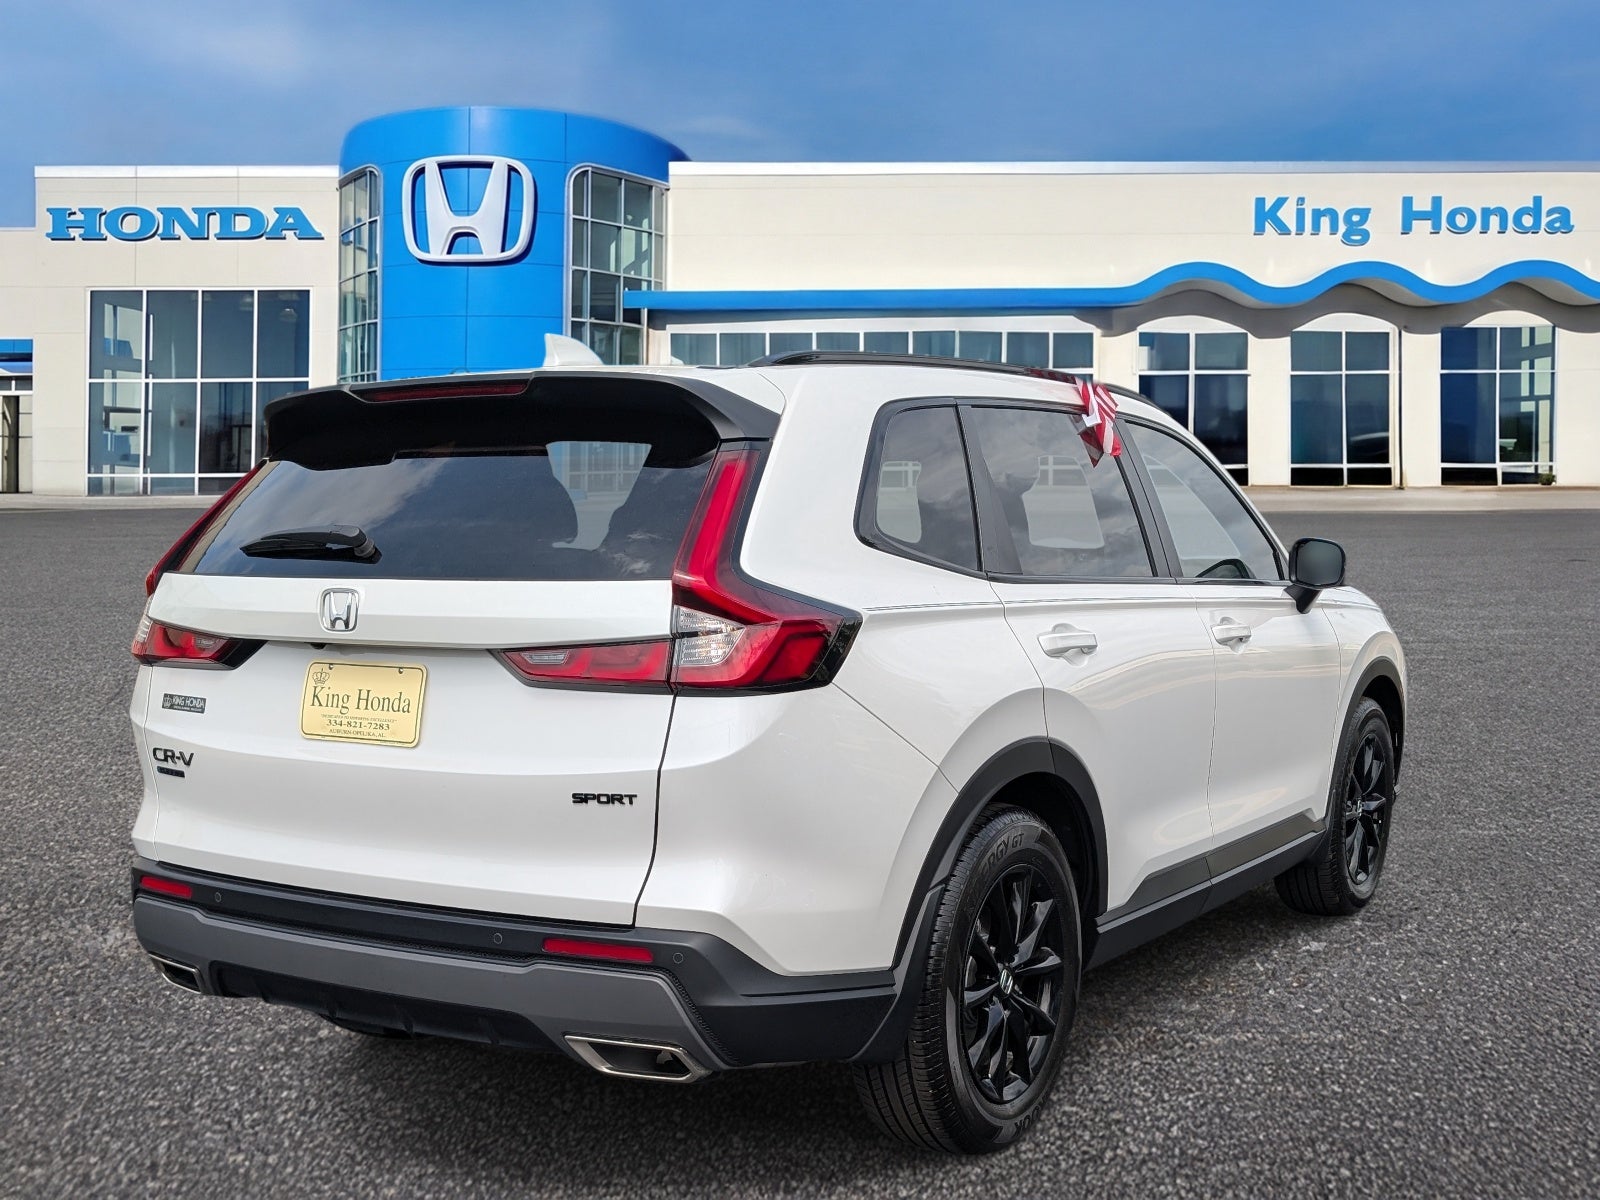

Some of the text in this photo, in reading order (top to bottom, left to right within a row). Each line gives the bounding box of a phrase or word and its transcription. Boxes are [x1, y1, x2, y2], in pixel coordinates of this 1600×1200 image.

[46, 206, 324, 241] HONDA
[1254, 196, 1575, 246] King Honda
[185, 696, 205, 709] HONDA
[310, 685, 411, 715] King Honda
[326, 719, 390, 730] 334-821-7283
[153, 747, 194, 767] CR-V
[572, 793, 637, 805] SPORT
